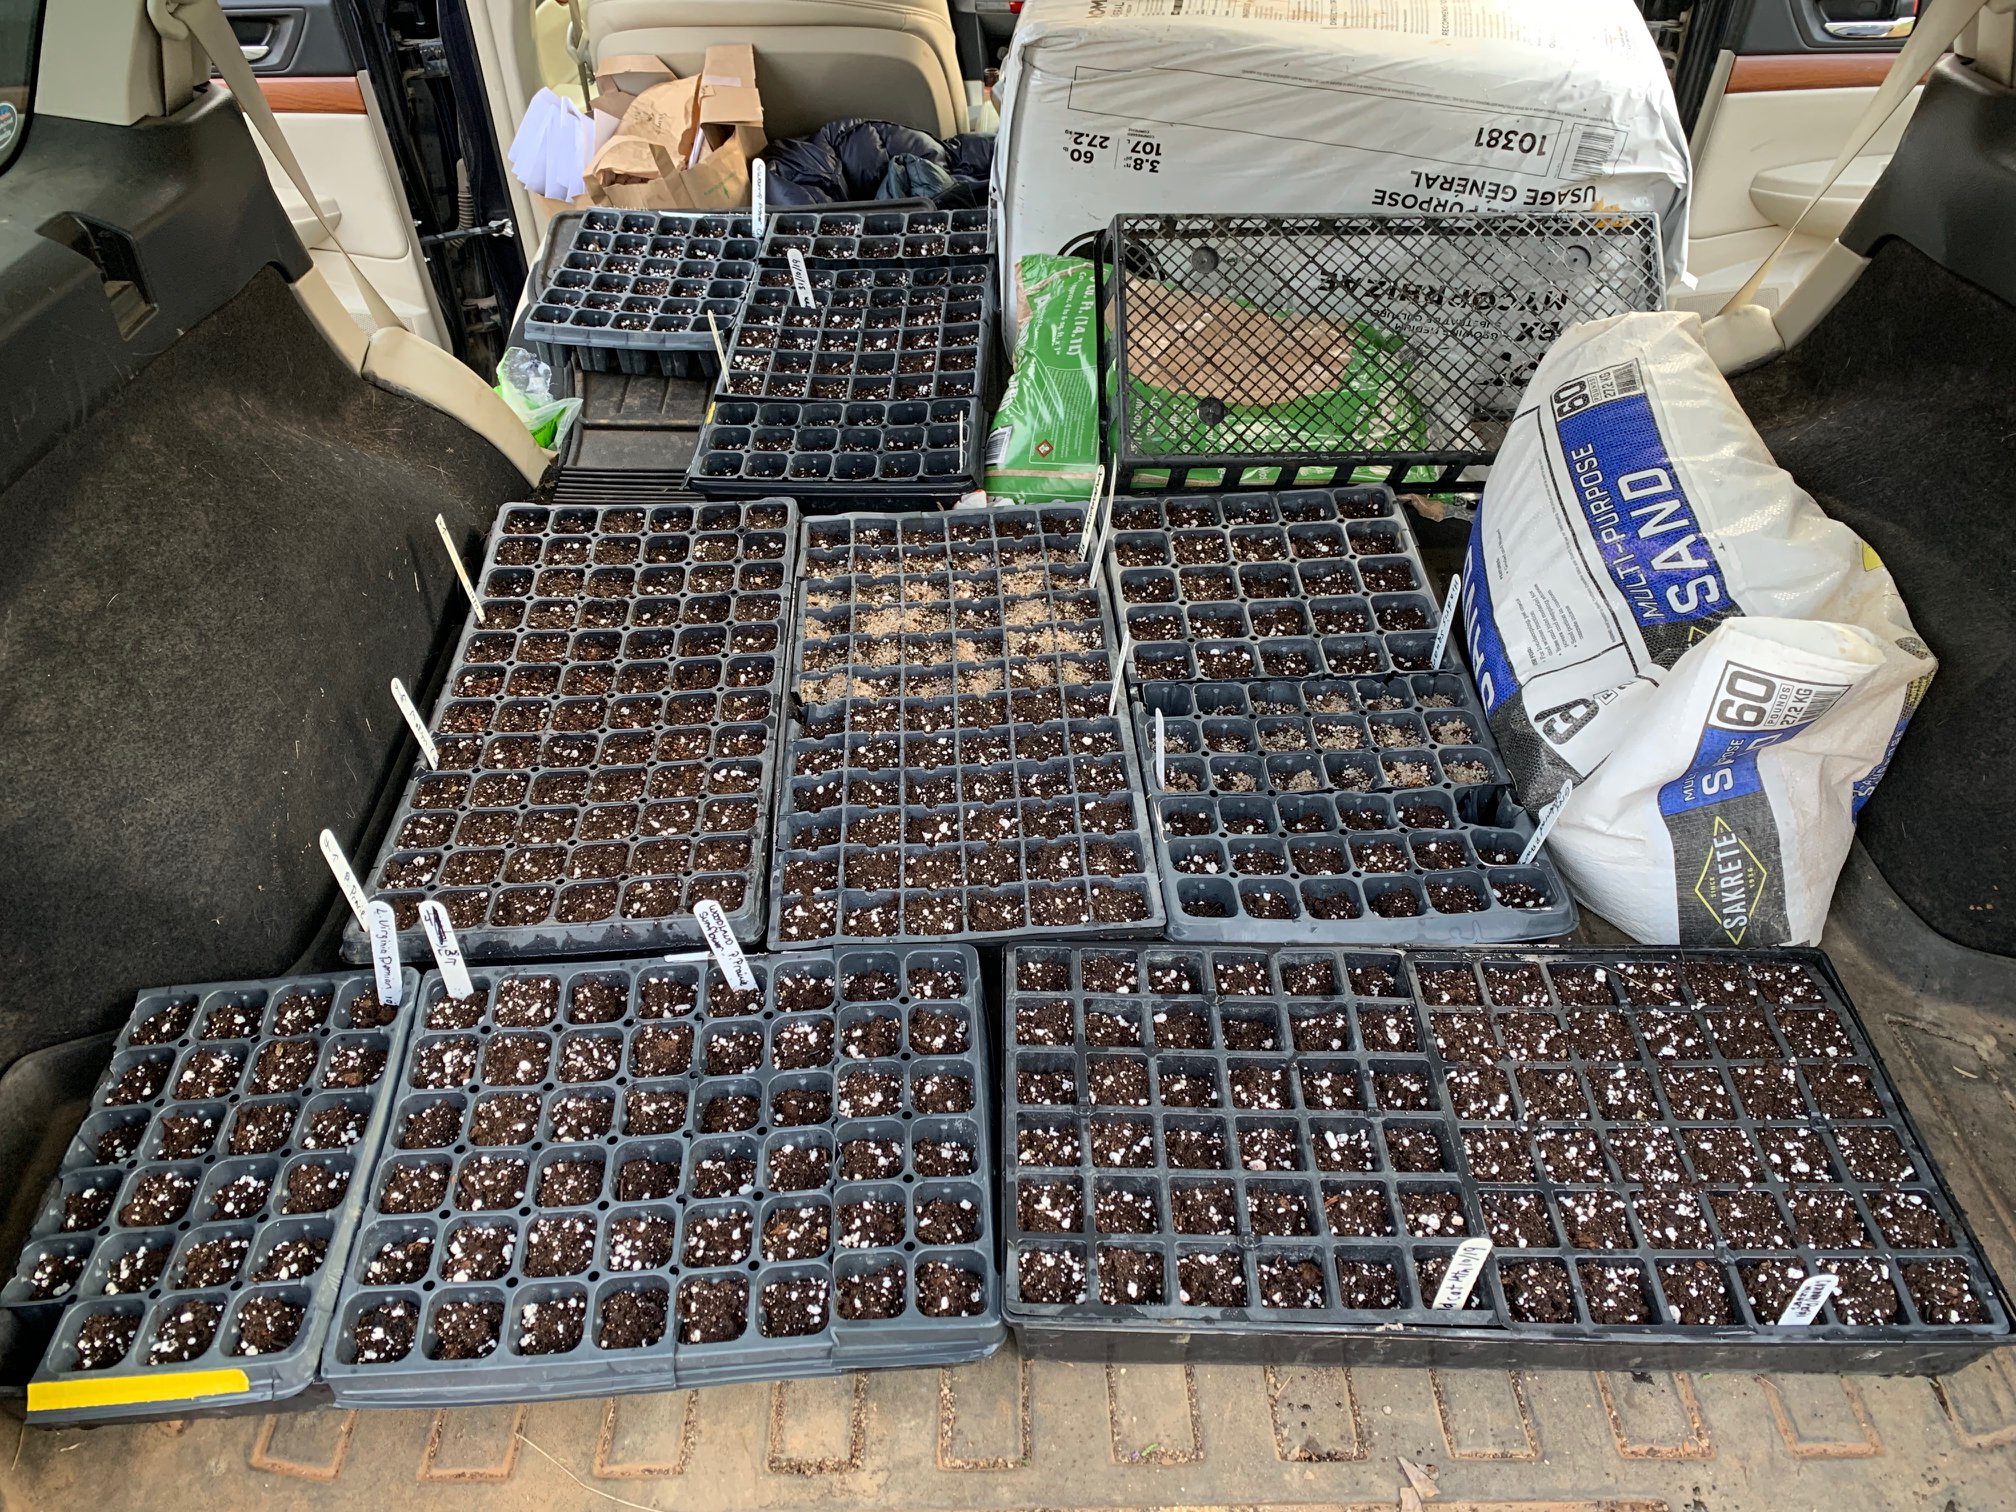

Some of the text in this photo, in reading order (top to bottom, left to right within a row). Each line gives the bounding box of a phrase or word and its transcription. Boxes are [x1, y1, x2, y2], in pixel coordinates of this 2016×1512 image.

[1070, 149, 1094, 163] 60
[1073, 132, 1110, 149] 27.2
[1131, 141, 1161, 156] 107
[1474, 126, 1548, 157] 10381
[1133, 158, 1160, 173] 3.8
[1409, 170, 1597, 206] USAGE GÉNÉRAL
[1078, 301, 1094, 313] Ft.
[1066, 316, 1089, 356] (14.1L)
[1555, 378, 1591, 420] 60
[1573, 442, 1659, 621] MULTI-PURPOSE
[1618, 467, 1720, 614] SAND
[1716, 670, 1776, 727] 60
[1768, 686, 1791, 725] POUNDS
[1780, 687, 1814, 726] 27.2 KG
[1718, 831, 1748, 930] SAKRETE
